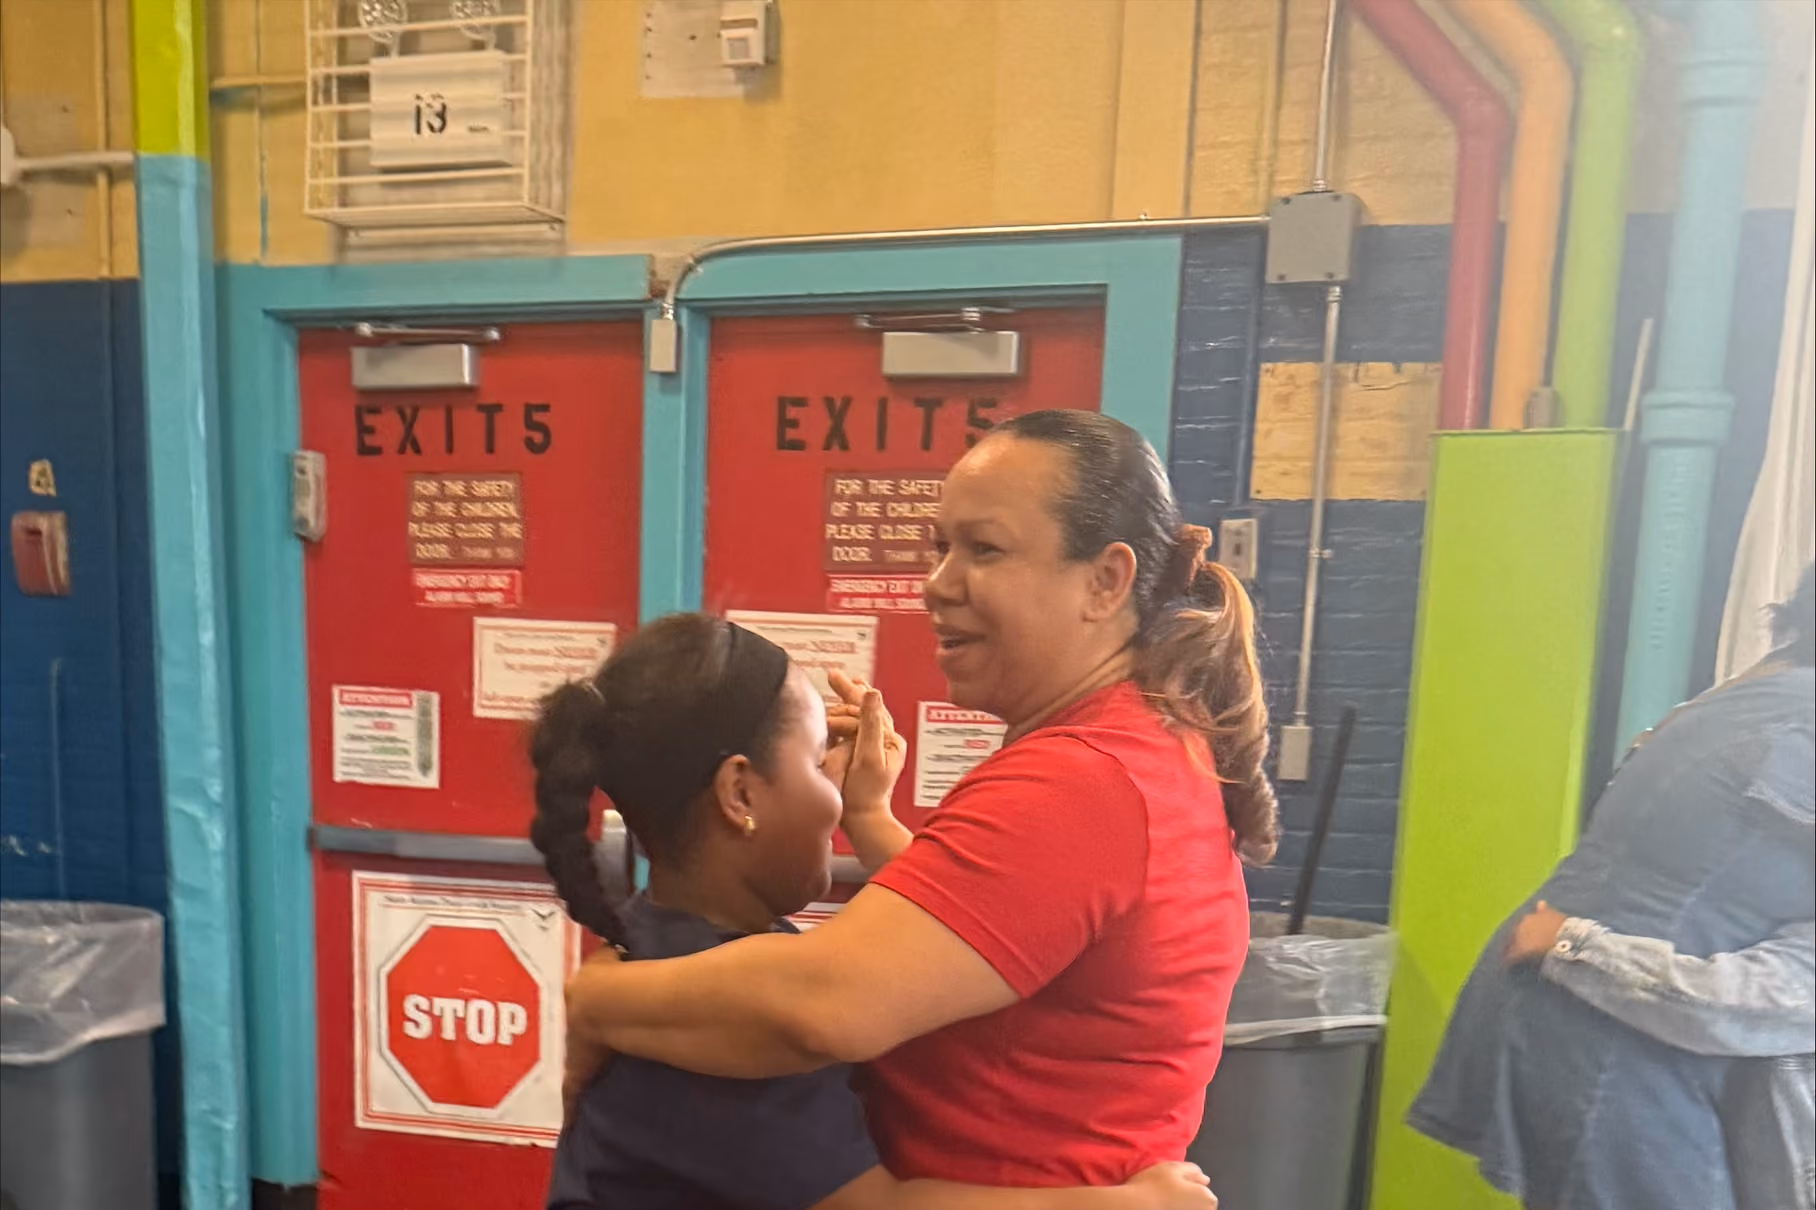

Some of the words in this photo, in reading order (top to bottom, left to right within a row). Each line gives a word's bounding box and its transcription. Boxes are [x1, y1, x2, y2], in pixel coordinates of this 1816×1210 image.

[414, 480, 440, 496] FOR
[835, 479, 863, 495] FOR
[866, 479, 896, 496] THE
[831, 501, 852, 517] OF
[855, 501, 881, 518] THE
[886, 501, 941, 518] CHILDRE
[408, 521, 453, 539] PLEASE
[825, 523, 875, 540] PLEASE
[879, 524, 922, 541] CLOSE
[402, 993, 528, 1046] STOP
